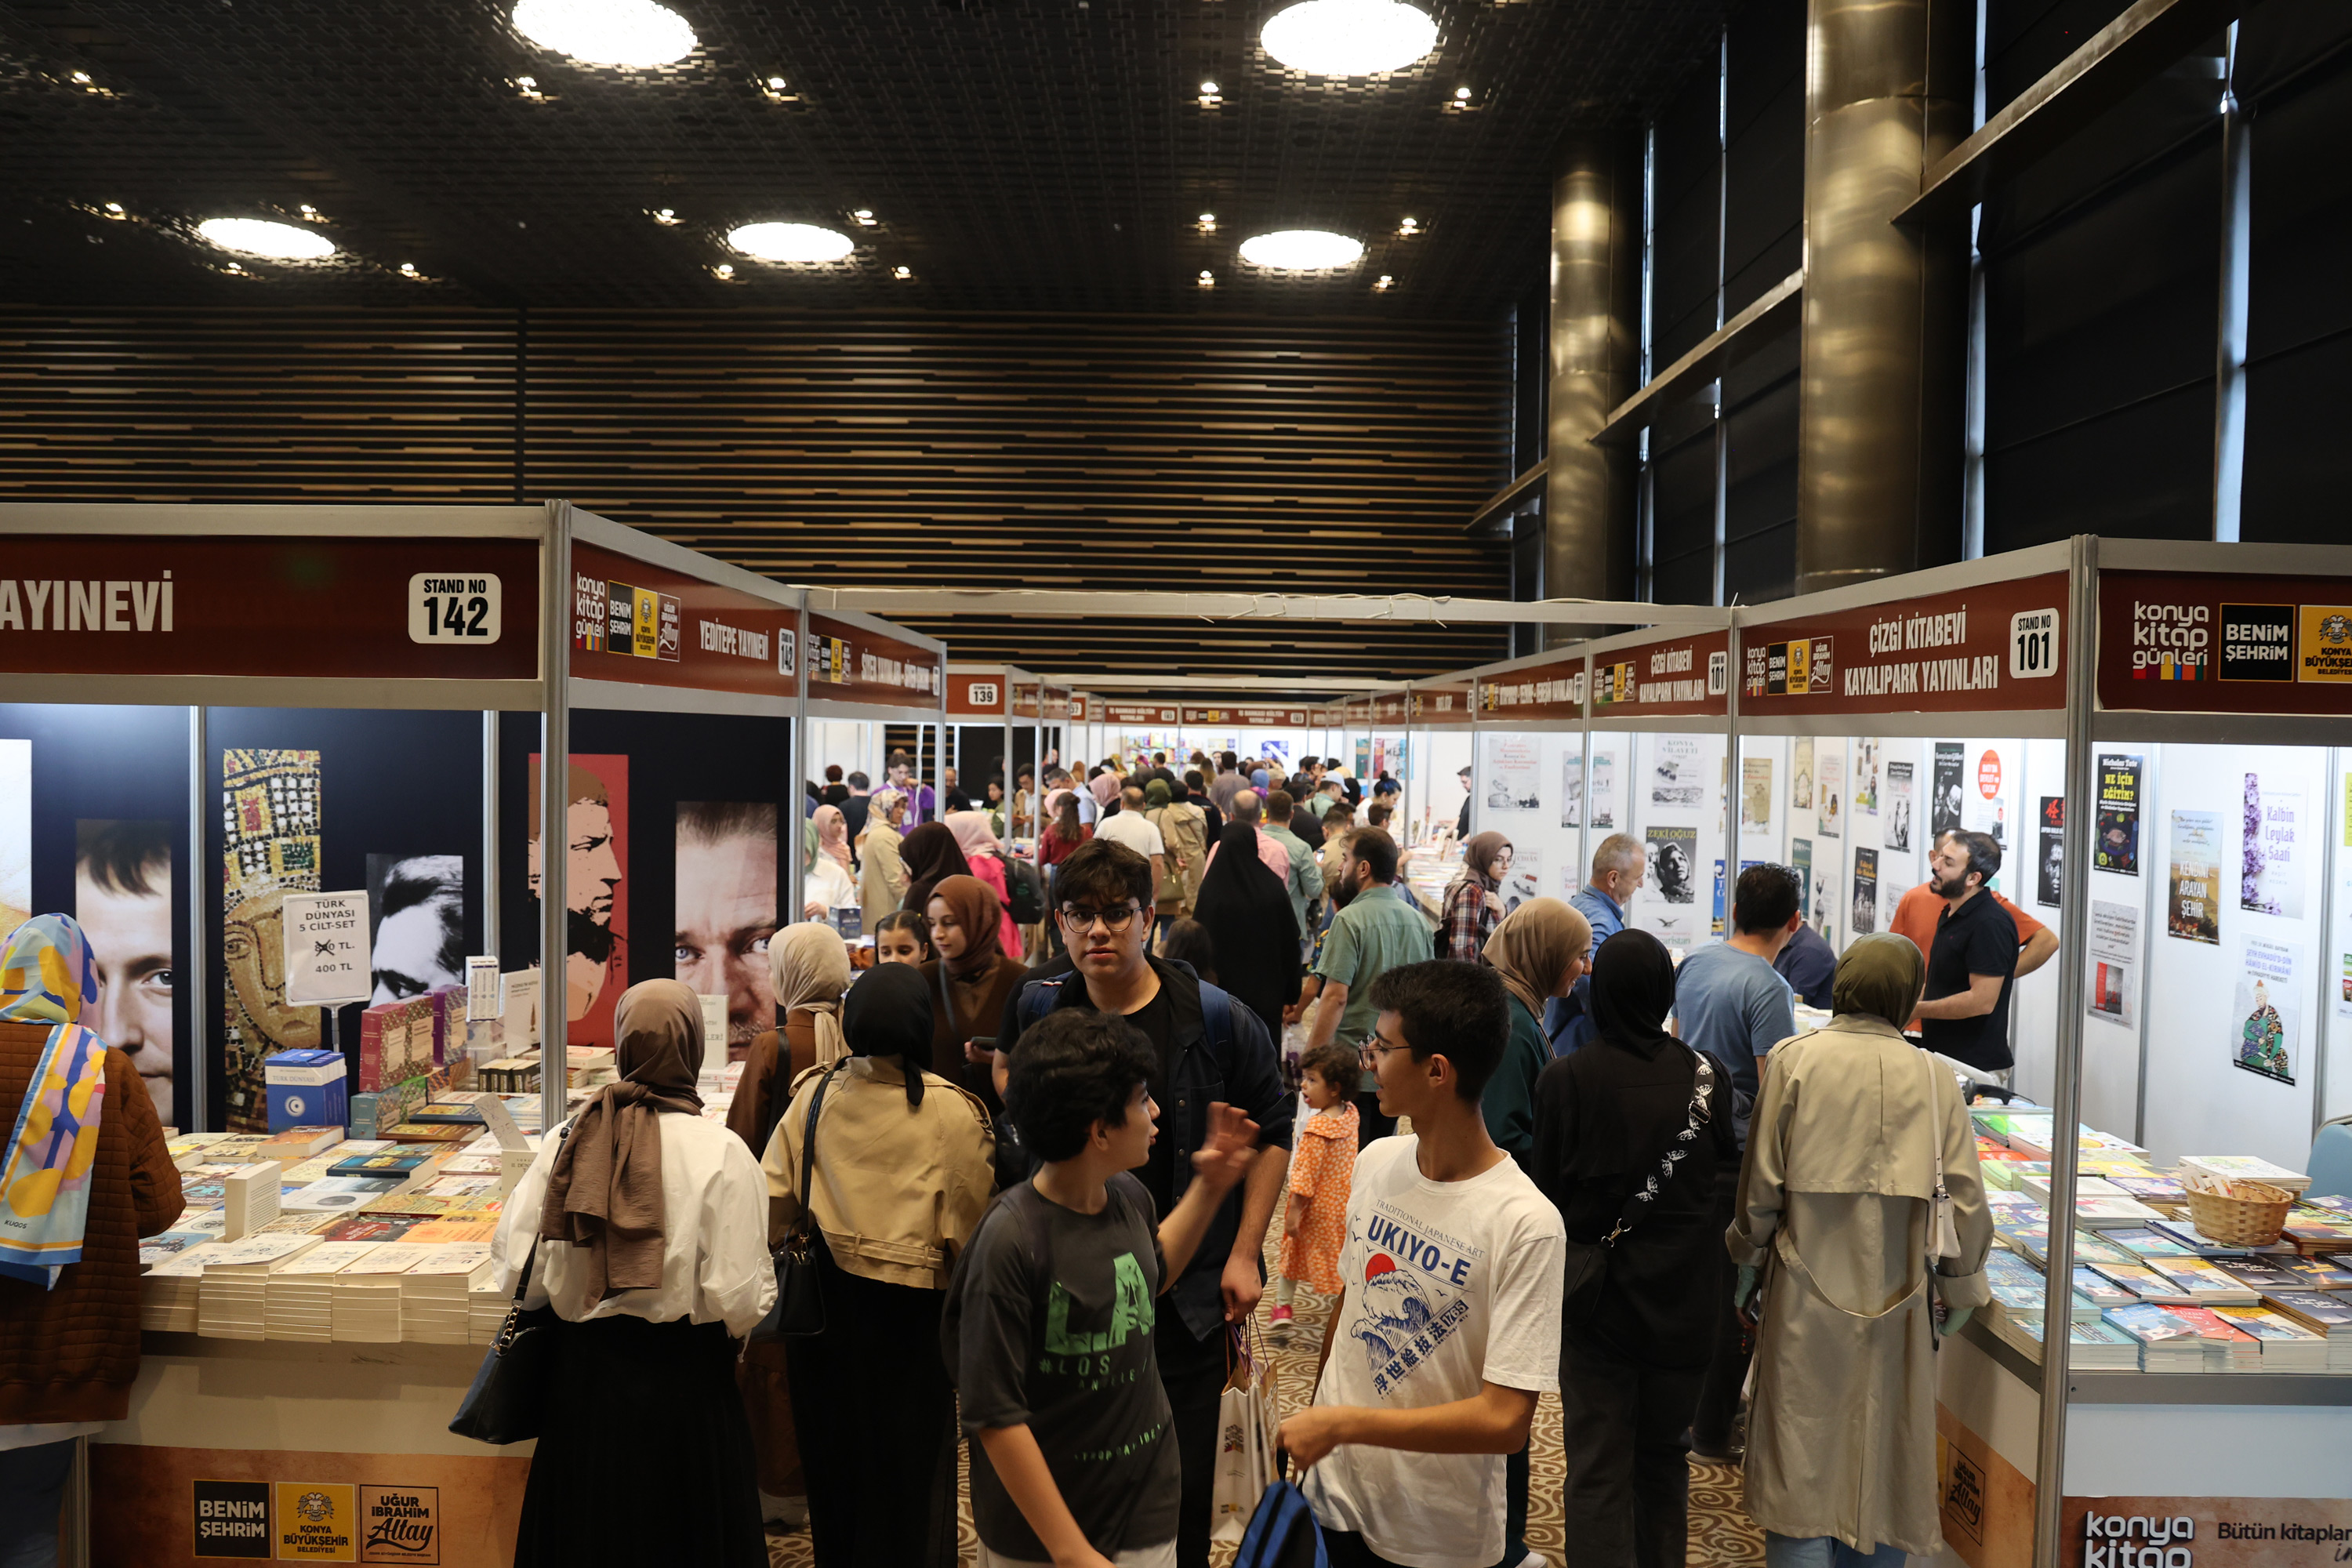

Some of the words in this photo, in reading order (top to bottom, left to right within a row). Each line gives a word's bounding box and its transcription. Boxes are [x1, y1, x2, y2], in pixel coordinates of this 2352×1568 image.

[423, 579, 464, 593] STAND
[468, 579, 486, 593] NO
[576, 572, 605, 600] konya
[423, 596, 488, 636] 142
[576, 592, 605, 624] kitap
[2134, 601, 2209, 626] konya
[575, 619, 604, 639] günleri
[1869, 614, 1903, 658] ÇİZGİ
[1906, 604, 1966, 650] KİTABEVİ
[2018, 615, 2040, 631] STAND
[2041, 614, 2052, 628] NO
[699, 617, 737, 655] YEDİTEPE
[738, 630, 769, 661] YAYINEVİ
[2133, 622, 2209, 651] kitap
[1650, 648, 1666, 677] ÇİZGİ
[1667, 645, 1693, 673] KİTABEVİ
[1748, 647, 1766, 661] konya
[2017, 631, 2050, 671] 101
[2132, 648, 2209, 670] günleri
[2321, 648, 2352, 656] KONYA
[1711, 666, 1725, 690] 101
[1747, 660, 1766, 677] kitap
[1845, 662, 1920, 696] KAYALIPARK
[1922, 655, 1998, 692] YAYINLARI
[974, 691, 993, 702] 139
[1673, 679, 1704, 701] YAYINLARI
[2105, 774, 2116, 784] NE
[2117, 771, 2134, 789] İÇİN
[2103, 786, 2134, 800] EĞİTİM?
[2267, 806, 2295, 822] Kalbin
[1647, 829, 1668, 838] ZEKİ
[1670, 829, 1696, 839] OĞUZ
[2265, 826, 2295, 844] Leylak
[2268, 845, 2290, 862] Saati
[2179, 880, 2207, 898] ARAYAN
[314, 899, 346, 909] TÜRK
[2181, 898, 2204, 918] ŞEHİR
[305, 910, 355, 920] DÜNYASI
[310, 920, 356, 931] CİLT-SET
[1376, 1199, 1423, 1229] TRADITIONAL
[1424, 1225, 1465, 1250] JAPANESE
[1462, 1246, 1486, 1259] ART
[1367, 1215, 1472, 1287] UKIYO-E
[1442, 1301, 1468, 1327] 1765
[1374, 1321, 1447, 1395] 浮世絵技法
[380, 1494, 419, 1507] UĞUR
[299, 1525, 332, 1534] KONYA
[366, 1518, 434, 1552] Altay
[2086, 1511, 2194, 1545] konya
[2218, 1523, 2275, 1540] Bütün
[284, 1533, 349, 1546] BÜYÜKŞEHİR
